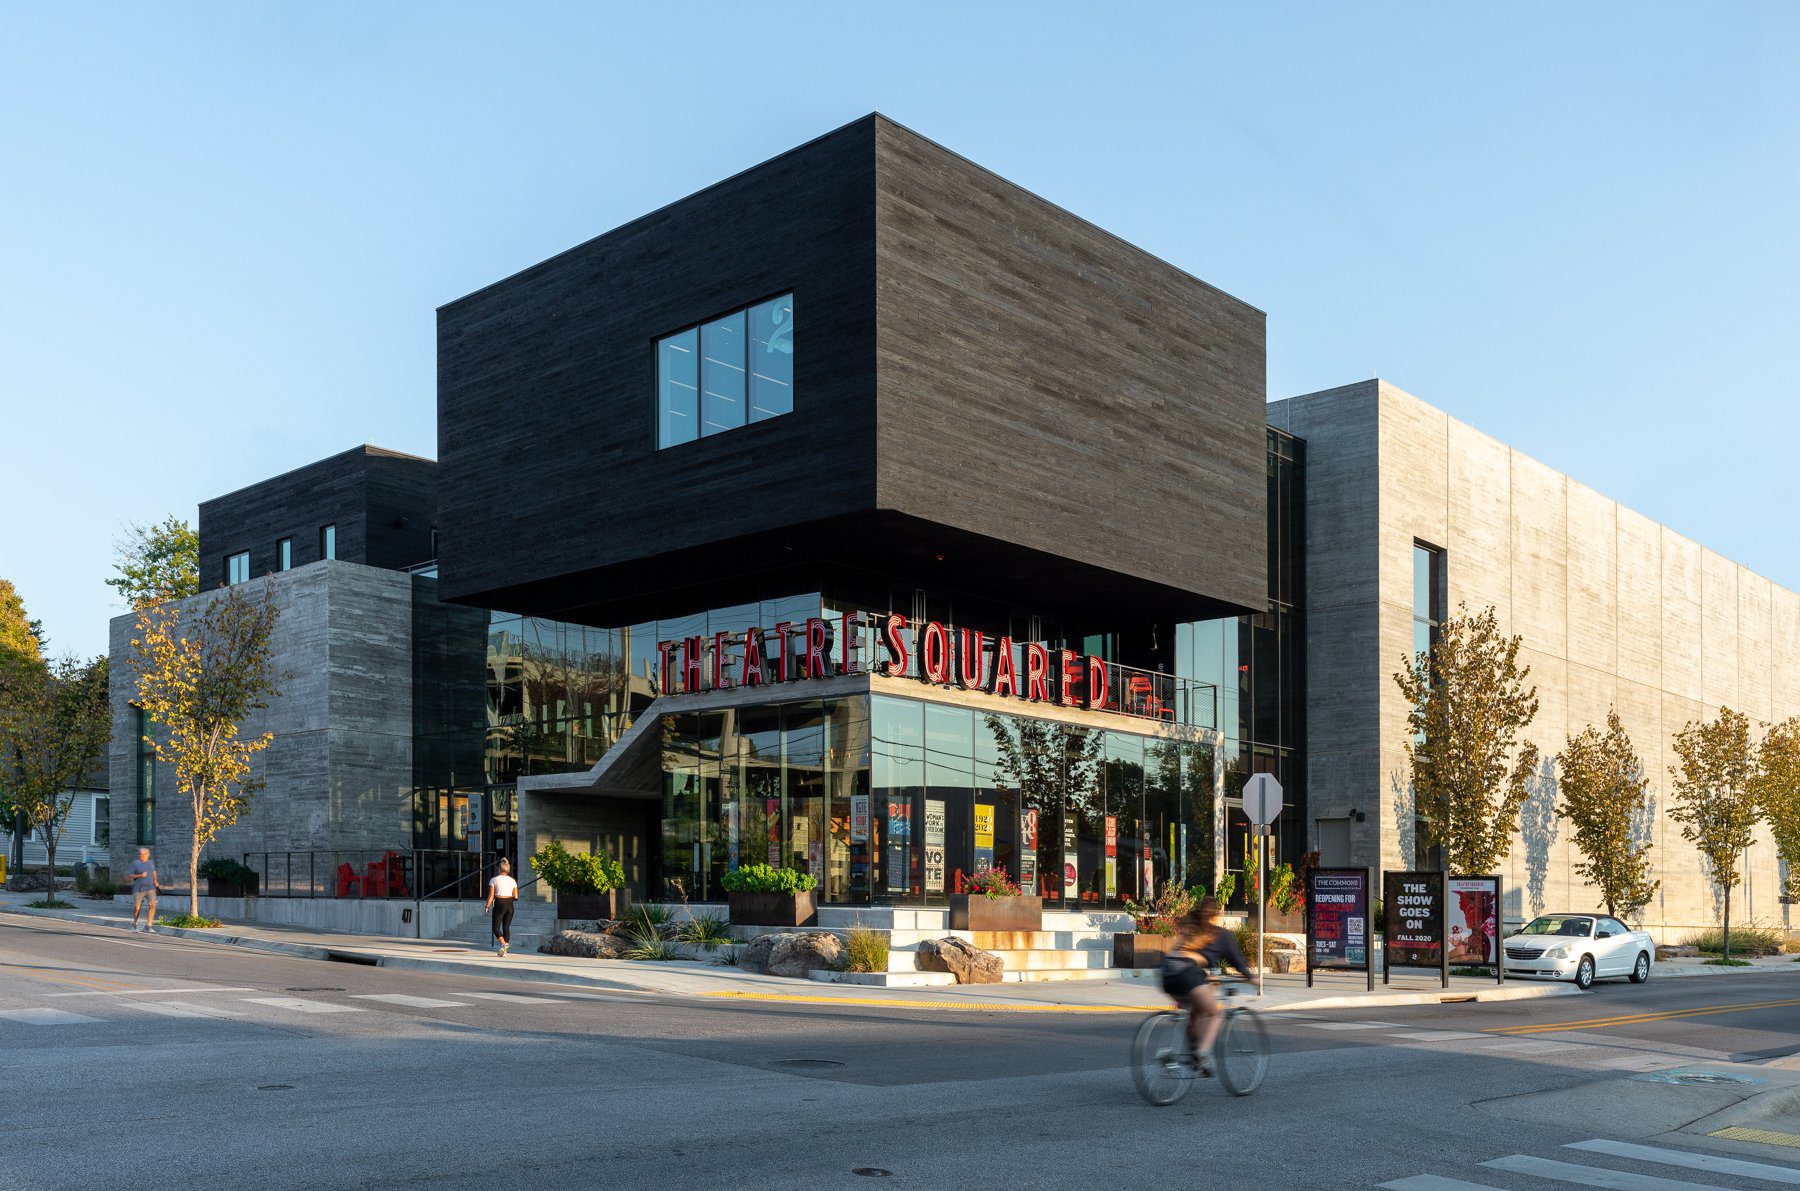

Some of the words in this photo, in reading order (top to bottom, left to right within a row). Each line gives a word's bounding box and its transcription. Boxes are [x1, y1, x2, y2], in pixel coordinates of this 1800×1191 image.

[1403, 883, 1426, 893] THE
[1315, 894, 1344, 903] REOPENING
[1345, 894, 1356, 903] FOR
[1397, 895, 1433, 905] SHOW
[1399, 907, 1431, 918] GOES
[1406, 919, 1423, 929] ON
